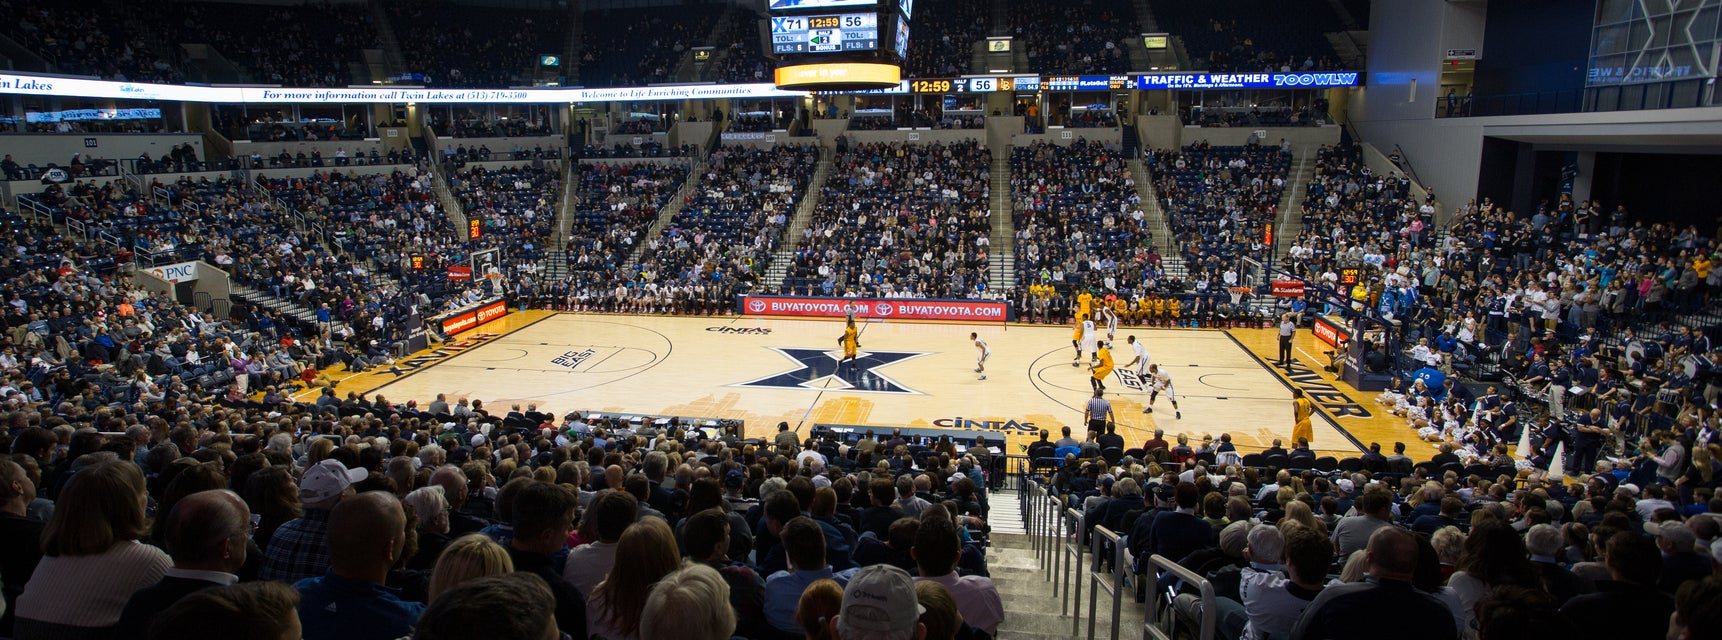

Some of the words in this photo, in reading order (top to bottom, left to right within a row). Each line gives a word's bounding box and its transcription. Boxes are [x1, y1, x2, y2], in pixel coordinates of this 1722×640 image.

[787, 19, 801, 30] 71
[809, 18, 839, 28] 12:59
[845, 16, 861, 27] 56
[846, 41, 863, 49] FLS:
[15, 78, 53, 91] Lakes
[1143, 75, 1194, 84] TRAFFIC
[1197, 75, 1206, 83] &
[1211, 74, 1269, 83] WEATHER
[912, 81, 950, 92] 12:59
[976, 81, 990, 90] 56
[263, 90, 281, 99] For
[315, 90, 377, 101] information
[380, 91, 397, 99] call
[400, 91, 424, 99] Twin
[426, 91, 454, 99] Lakes
[467, 91, 488, 100] (513)
[581, 91, 618, 99] Welcome
[630, 89, 646, 98] Life
[648, 87, 689, 97] Enriching
[692, 86, 752, 96] Communities
[166, 264, 193, 279] PNC
[1345, 275, 1355, 283] 30
[410, 304, 418, 316] X
[485, 305, 505, 317] TOYOTA
[771, 302, 868, 314] BUYATOYOTA.COM
[899, 305, 1001, 317] BUYATOYOTA.COM
[1320, 325, 1336, 340] TOYOTA
[1352, 327, 1359, 342] X
[372, 334, 500, 377] XAVIER
[550, 350, 578, 365] BIG
[561, 348, 595, 369] EAST
